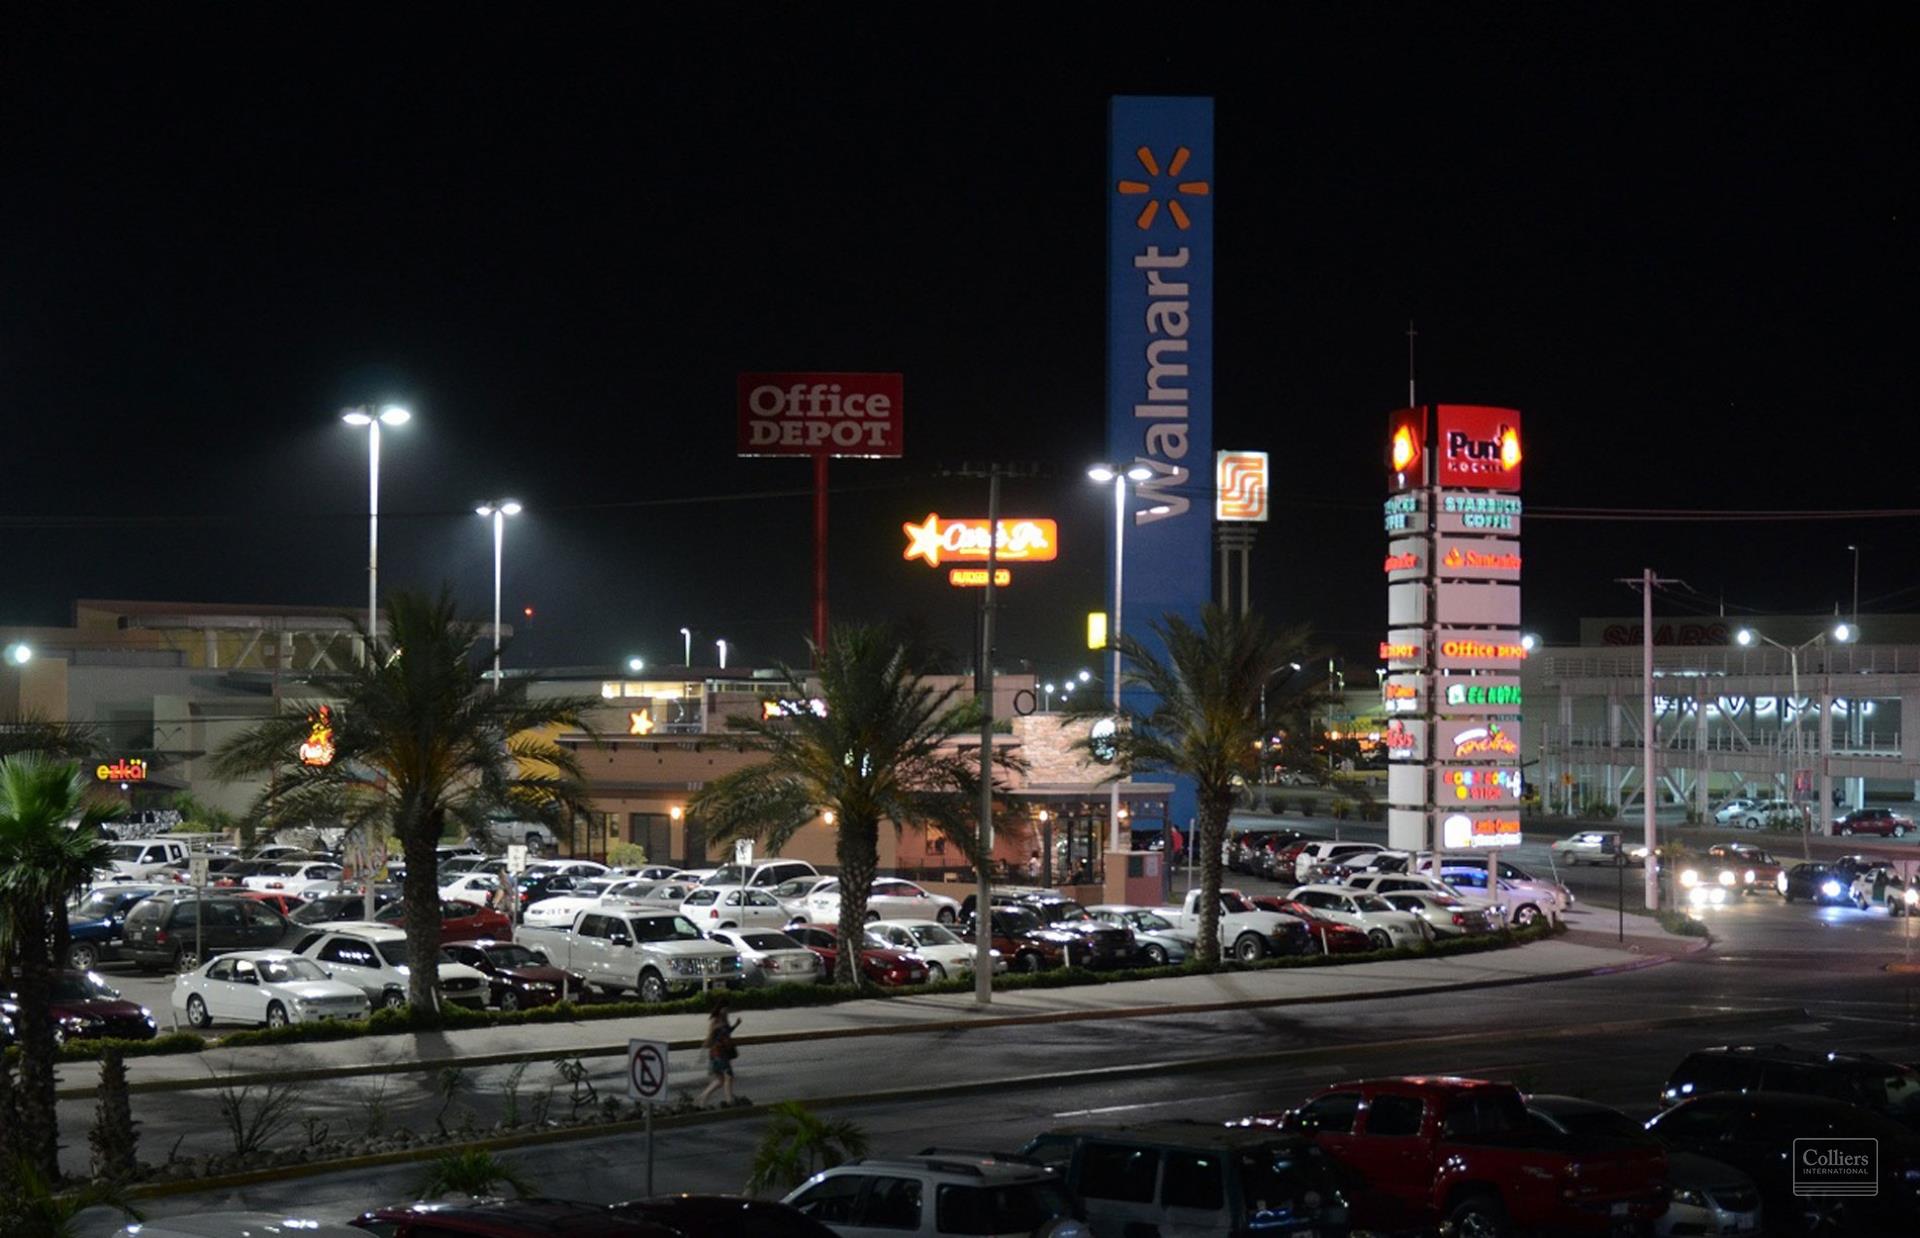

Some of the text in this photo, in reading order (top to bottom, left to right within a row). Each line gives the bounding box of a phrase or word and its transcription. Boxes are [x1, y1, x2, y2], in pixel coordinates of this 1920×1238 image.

[1134, 245, 1189, 525] Walmart
[749, 383, 891, 418] Office
[749, 420, 891, 446] DEPOT
[1603, 623, 1730, 646] SEARS
[1443, 640, 1494, 657] Office
